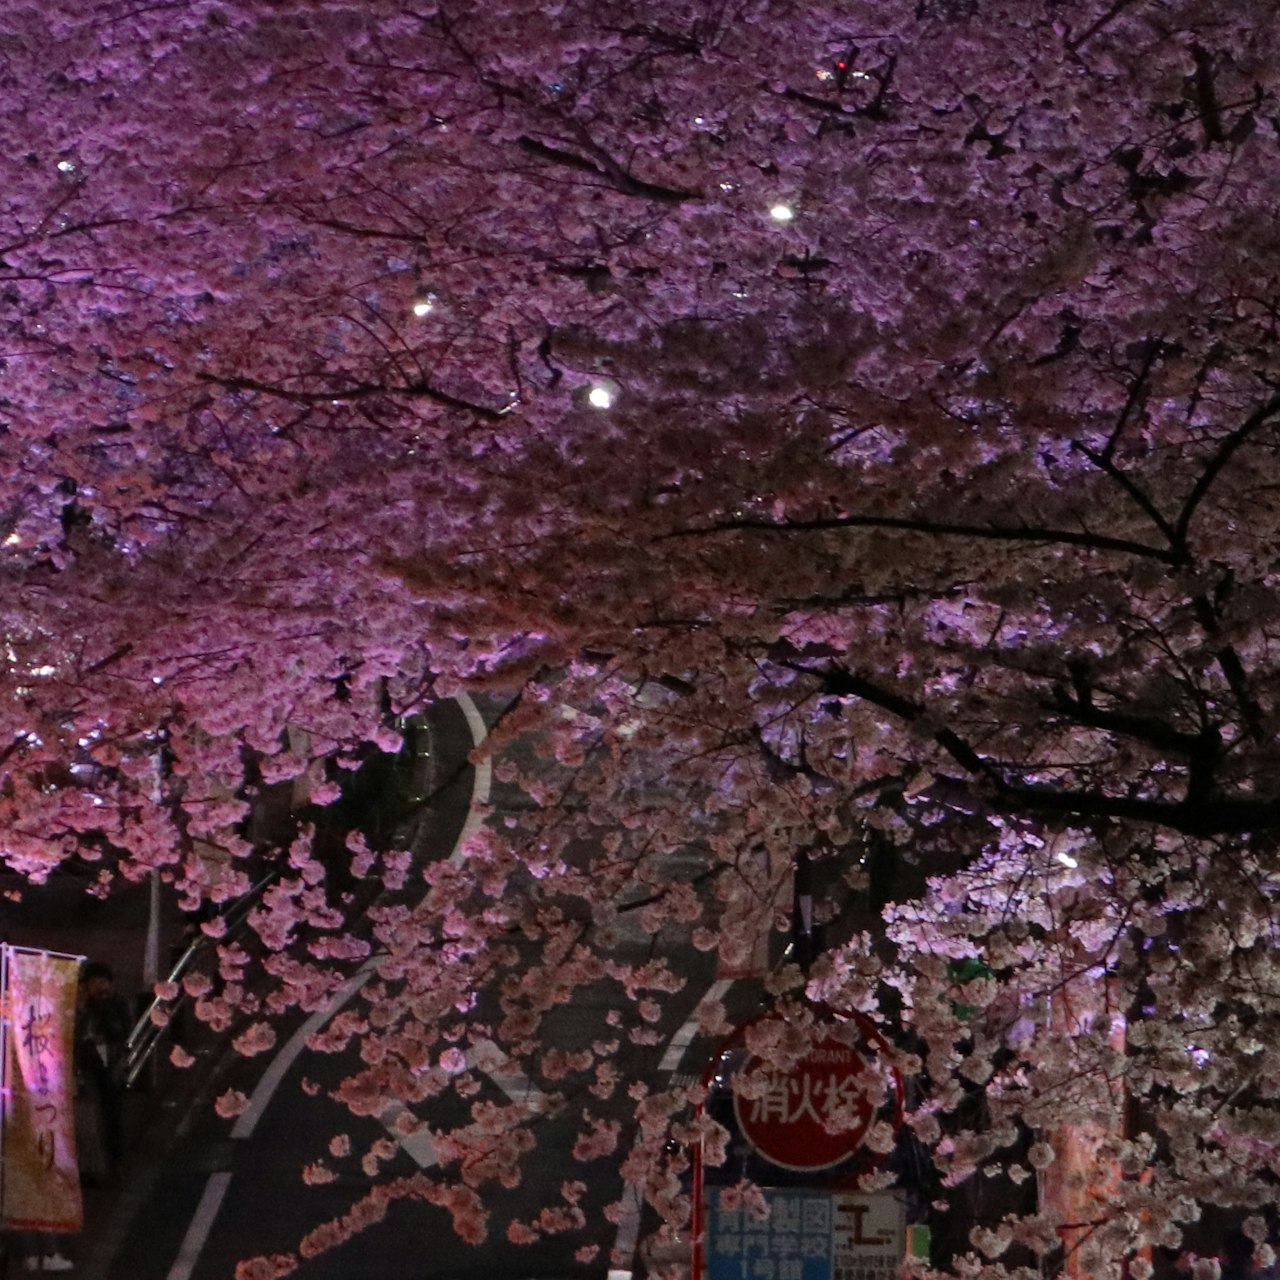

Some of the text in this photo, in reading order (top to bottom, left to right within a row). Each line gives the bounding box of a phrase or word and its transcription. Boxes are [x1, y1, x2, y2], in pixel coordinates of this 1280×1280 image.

[22, 1004, 57, 1170] 桜まつり
[749, 1072, 862, 1124] 消火栓
